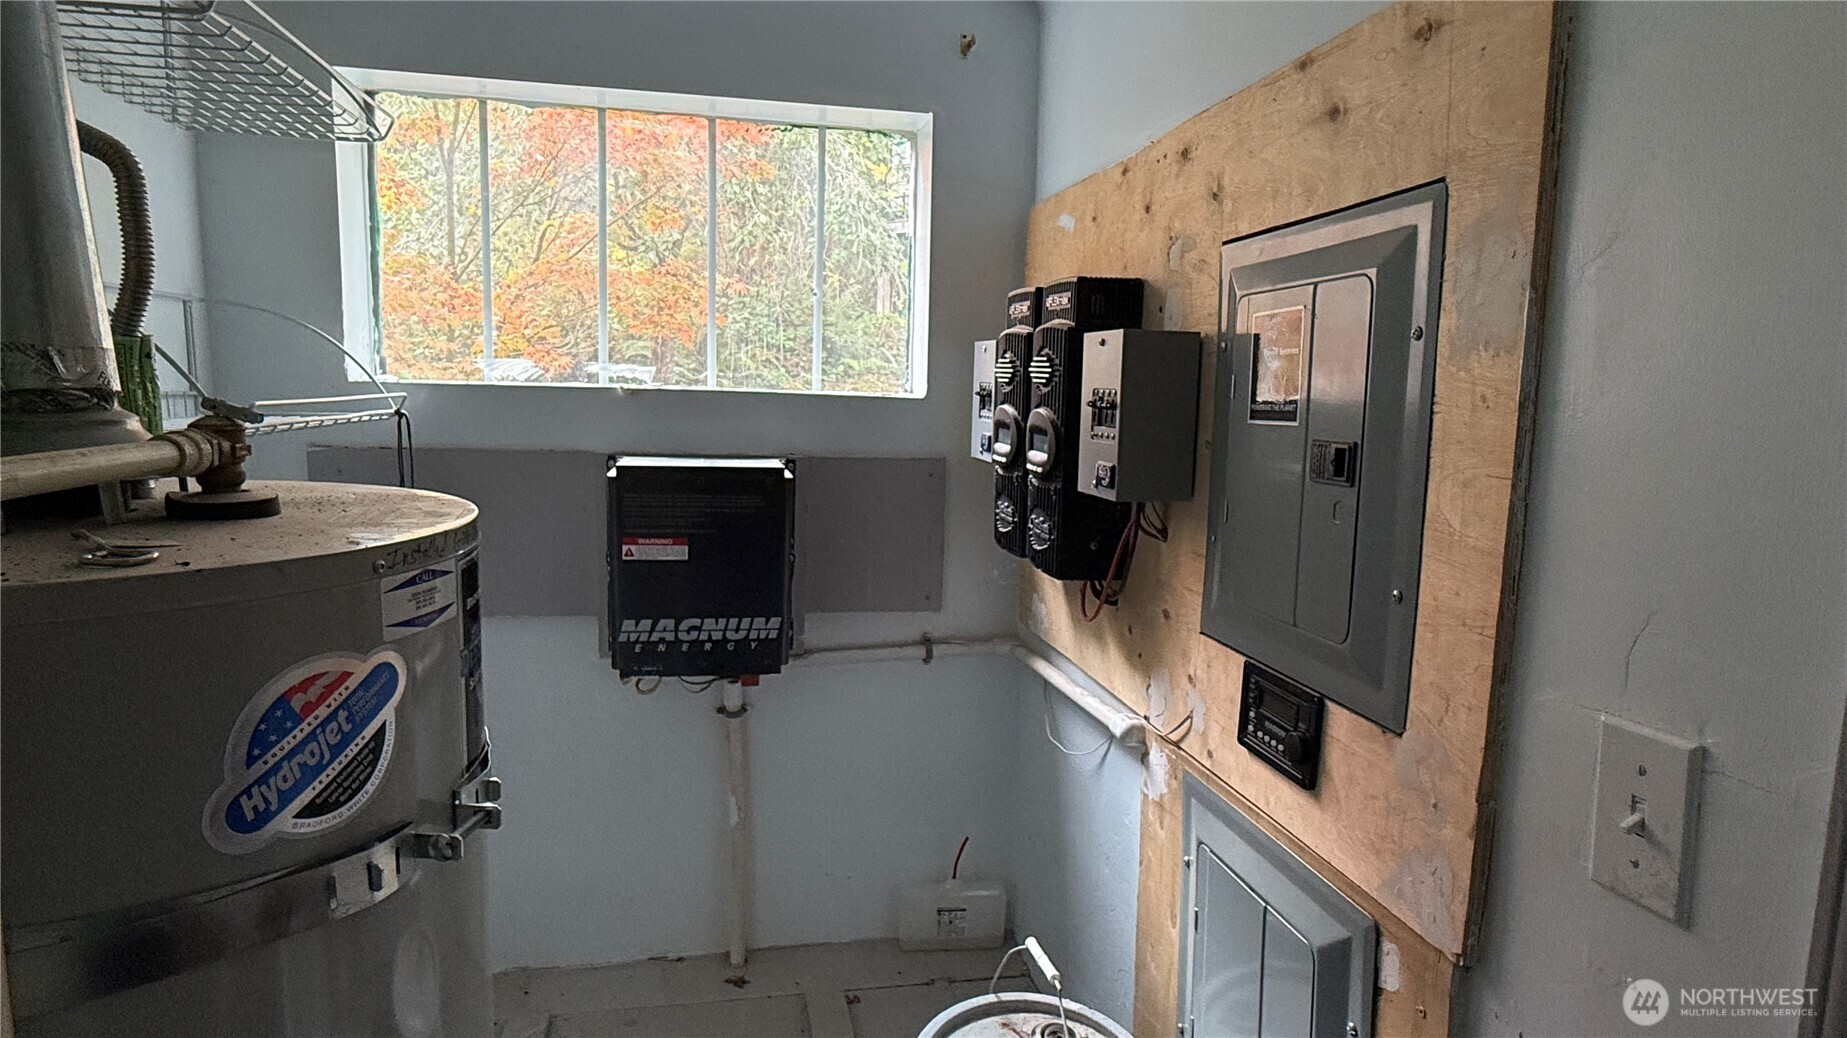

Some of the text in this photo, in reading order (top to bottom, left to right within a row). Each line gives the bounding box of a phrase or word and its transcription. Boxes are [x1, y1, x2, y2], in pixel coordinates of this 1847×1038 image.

[416, 572, 433, 583] CALL
[618, 617, 781, 642] MAGNUM
[634, 642, 758, 652] ENERGY
[240, 710, 352, 821] Hydrojet
[262, 714, 320, 766] EQUIPPED
[311, 735, 366, 792] FEATURING
[291, 721, 393, 829] BRADFORD WHITE CORPORATION
